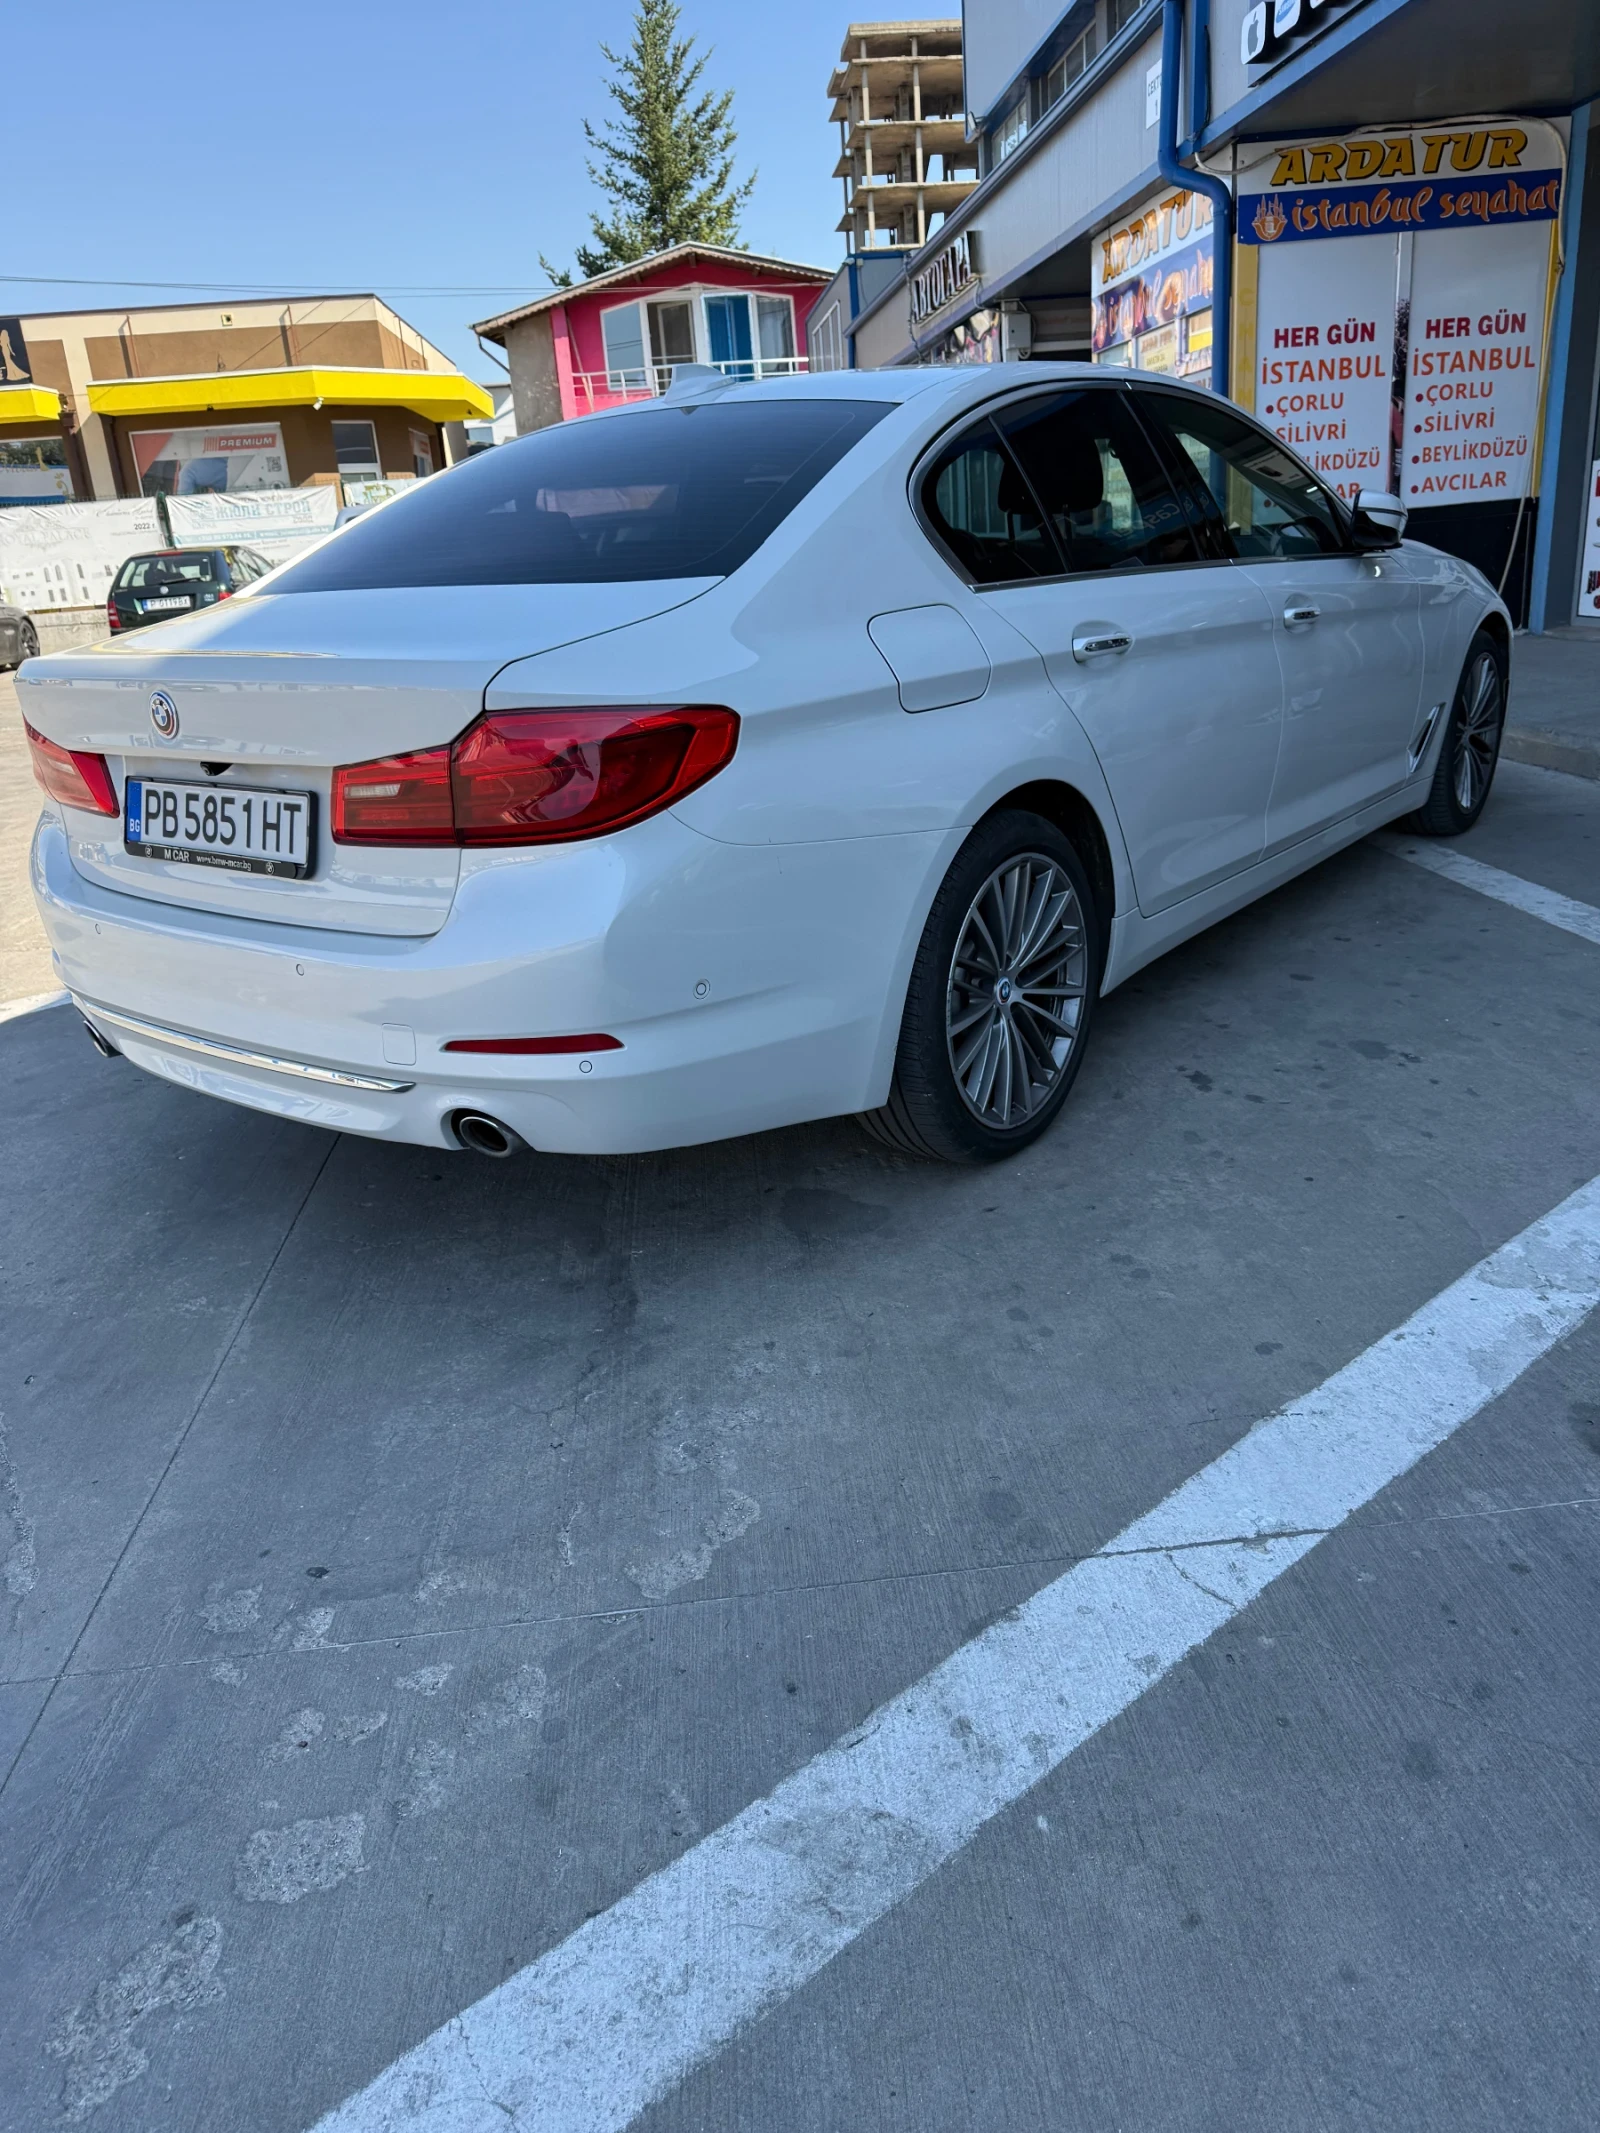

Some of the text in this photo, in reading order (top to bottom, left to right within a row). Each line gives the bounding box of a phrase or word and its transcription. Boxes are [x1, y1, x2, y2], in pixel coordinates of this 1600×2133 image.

[1439, 179, 1560, 222] seyahat
[1274, 318, 1376, 349] HER GÜN
[1425, 309, 1526, 339] HER GÜN
[1262, 355, 1386, 385] İSTANBUL
[1412, 346, 1535, 376] İSTANBUL
[1276, 392, 1344, 418] ÇORLU
[1426, 381, 1494, 407] ÇORLU
[1424, 407, 1495, 433] SİLİVRİ
[220, 437, 273, 447] PREMIUM
[1422, 435, 1528, 463] BEYLİKDÜZÜ
[1421, 471, 1507, 493] AVCILAR
[129, 818, 141, 833] BG
